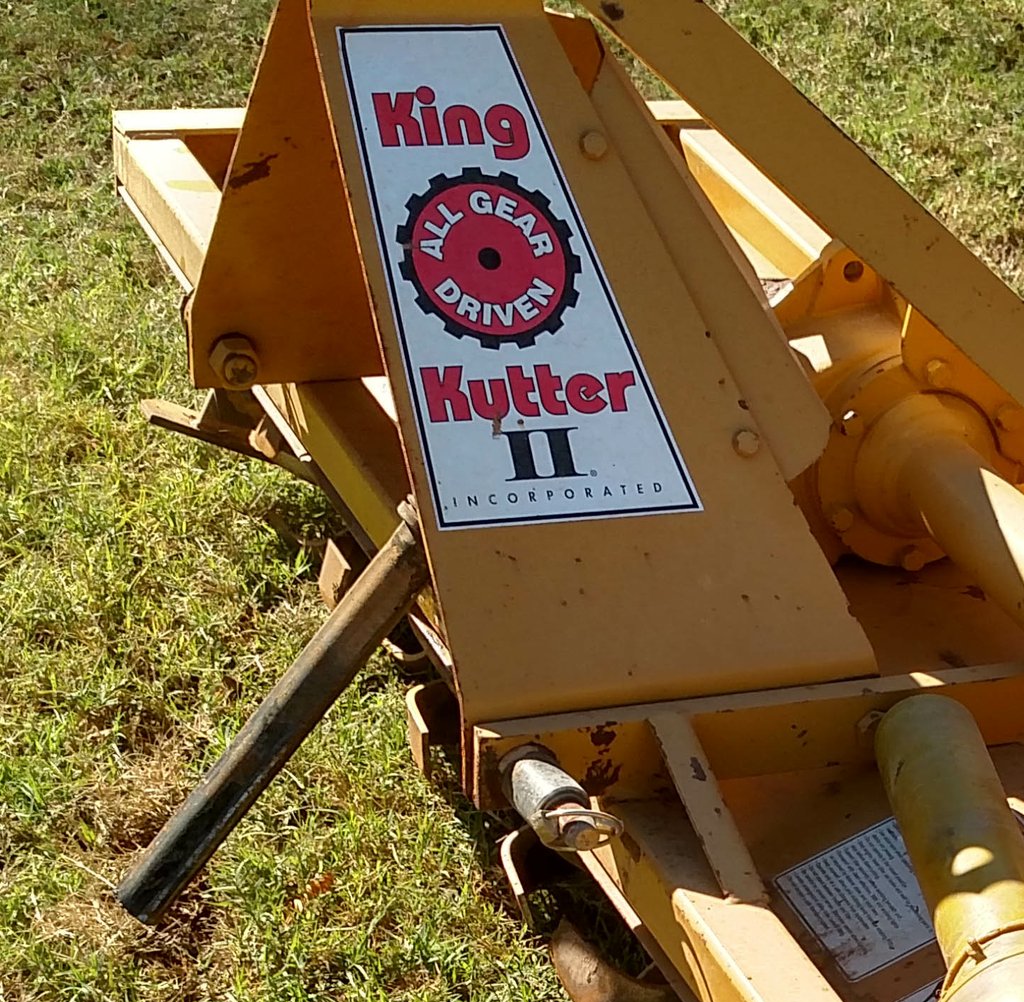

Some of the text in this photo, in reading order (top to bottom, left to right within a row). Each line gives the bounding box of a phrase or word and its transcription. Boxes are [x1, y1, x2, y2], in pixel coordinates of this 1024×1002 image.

[371, 86, 530, 160] King
[420, 190, 554, 261] ALL GEAR
[435, 277, 555, 327] DRIVEN
[419, 364, 636, 423] Kutter
[499, 427, 589, 482] II
[453, 482, 663, 508] INCORPORATED
